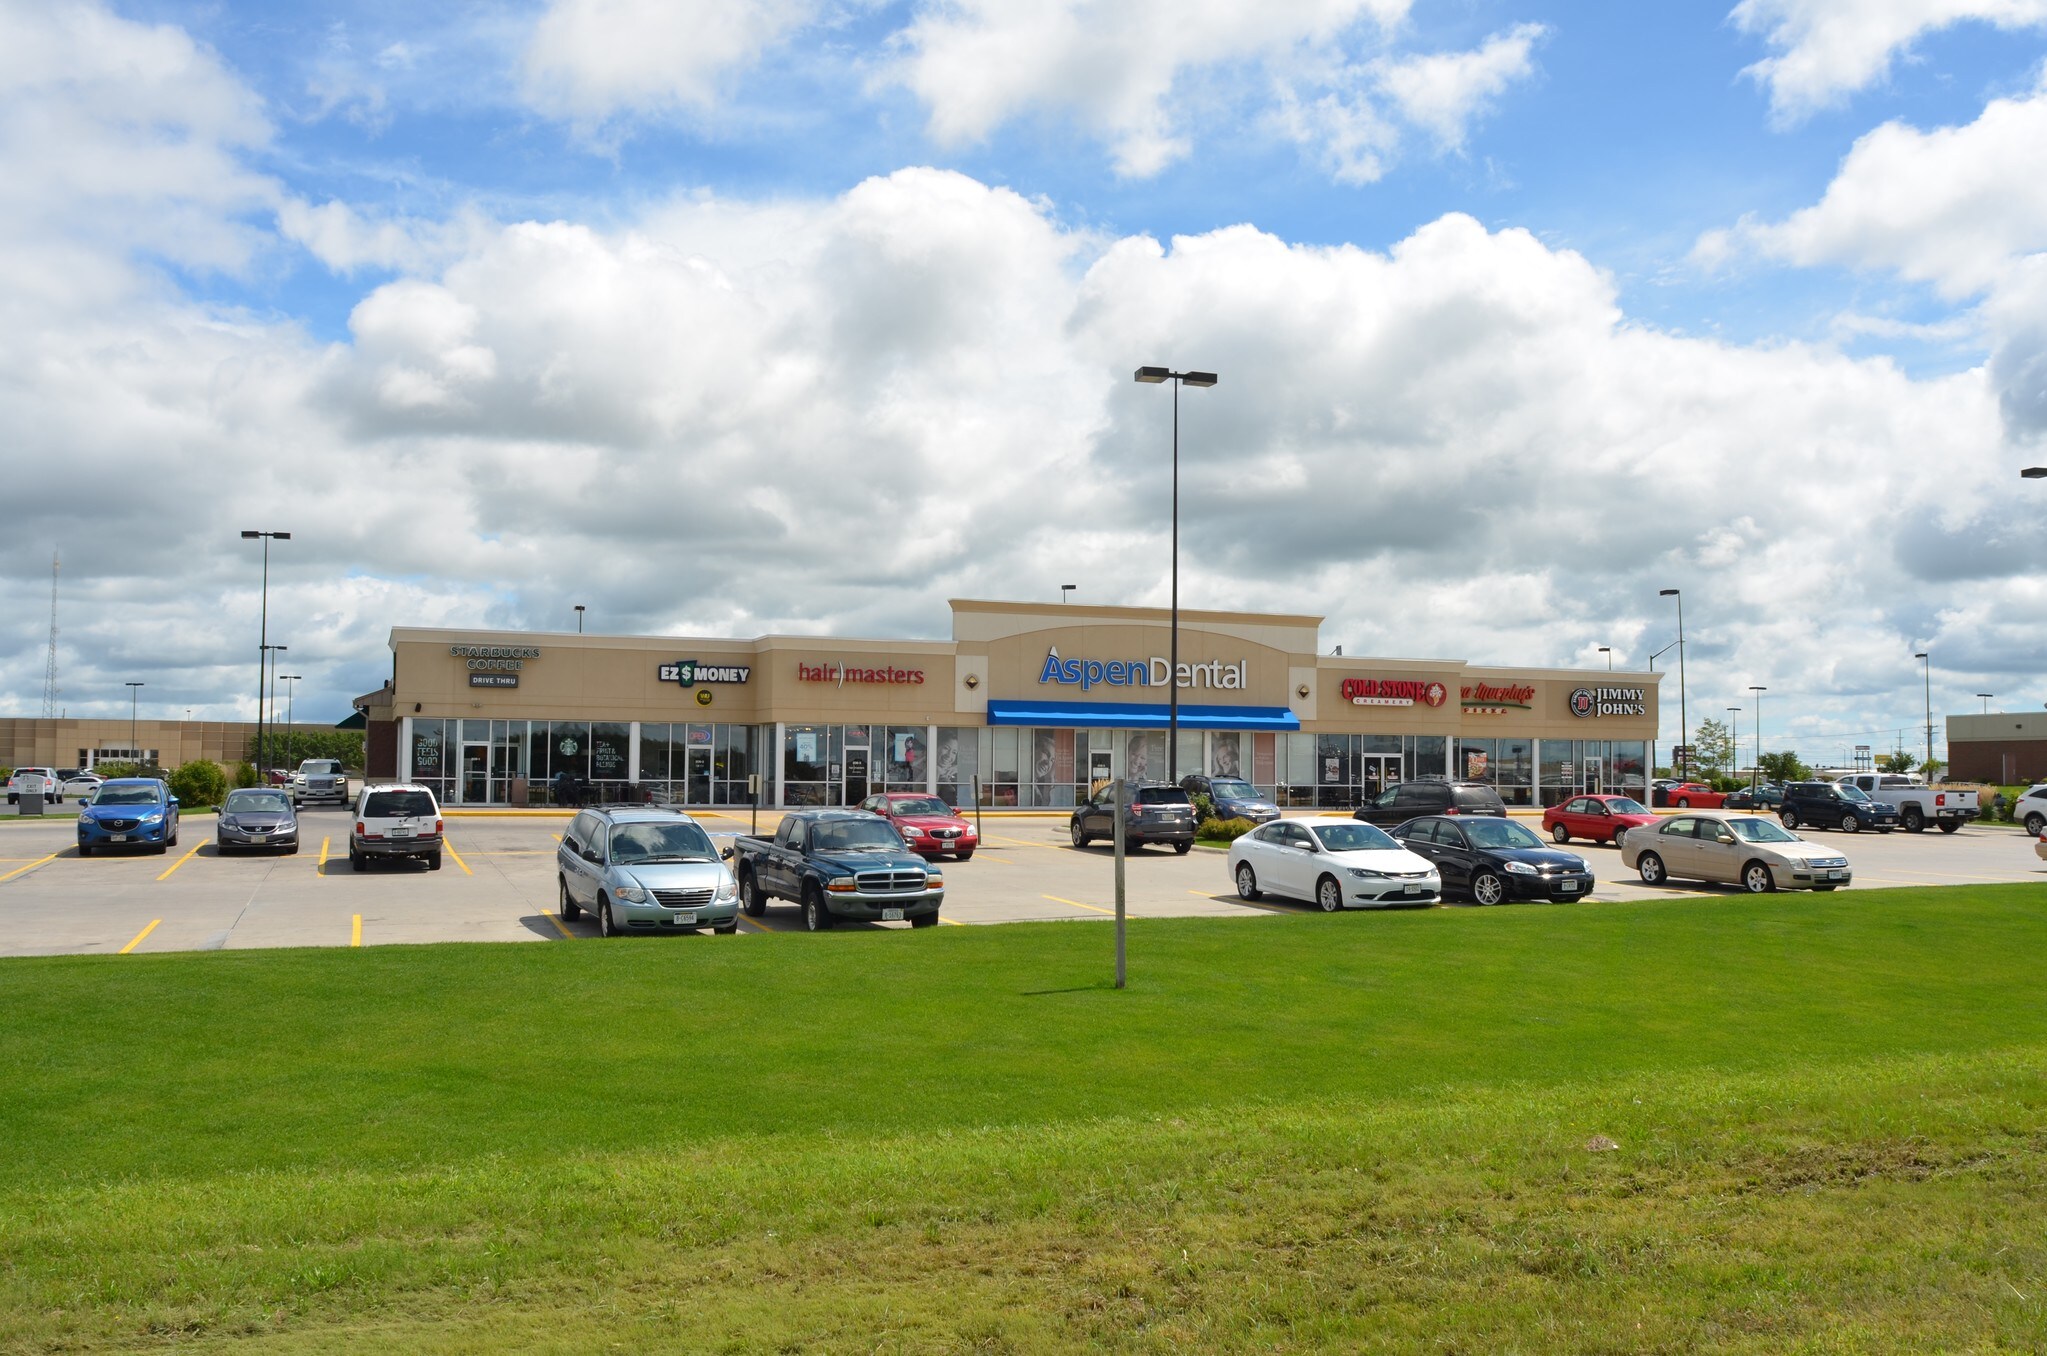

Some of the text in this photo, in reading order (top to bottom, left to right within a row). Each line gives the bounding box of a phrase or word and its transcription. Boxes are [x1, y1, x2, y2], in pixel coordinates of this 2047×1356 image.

[450, 646, 541, 658] STARBUCKS
[466, 658, 524, 671] COFFEE
[496, 677, 516, 685] THRU
[1342, 678, 1426, 702] COLD STONE
[1596, 688, 1645, 702] JIMMY
[1596, 703, 1646, 717] JOHN'S
